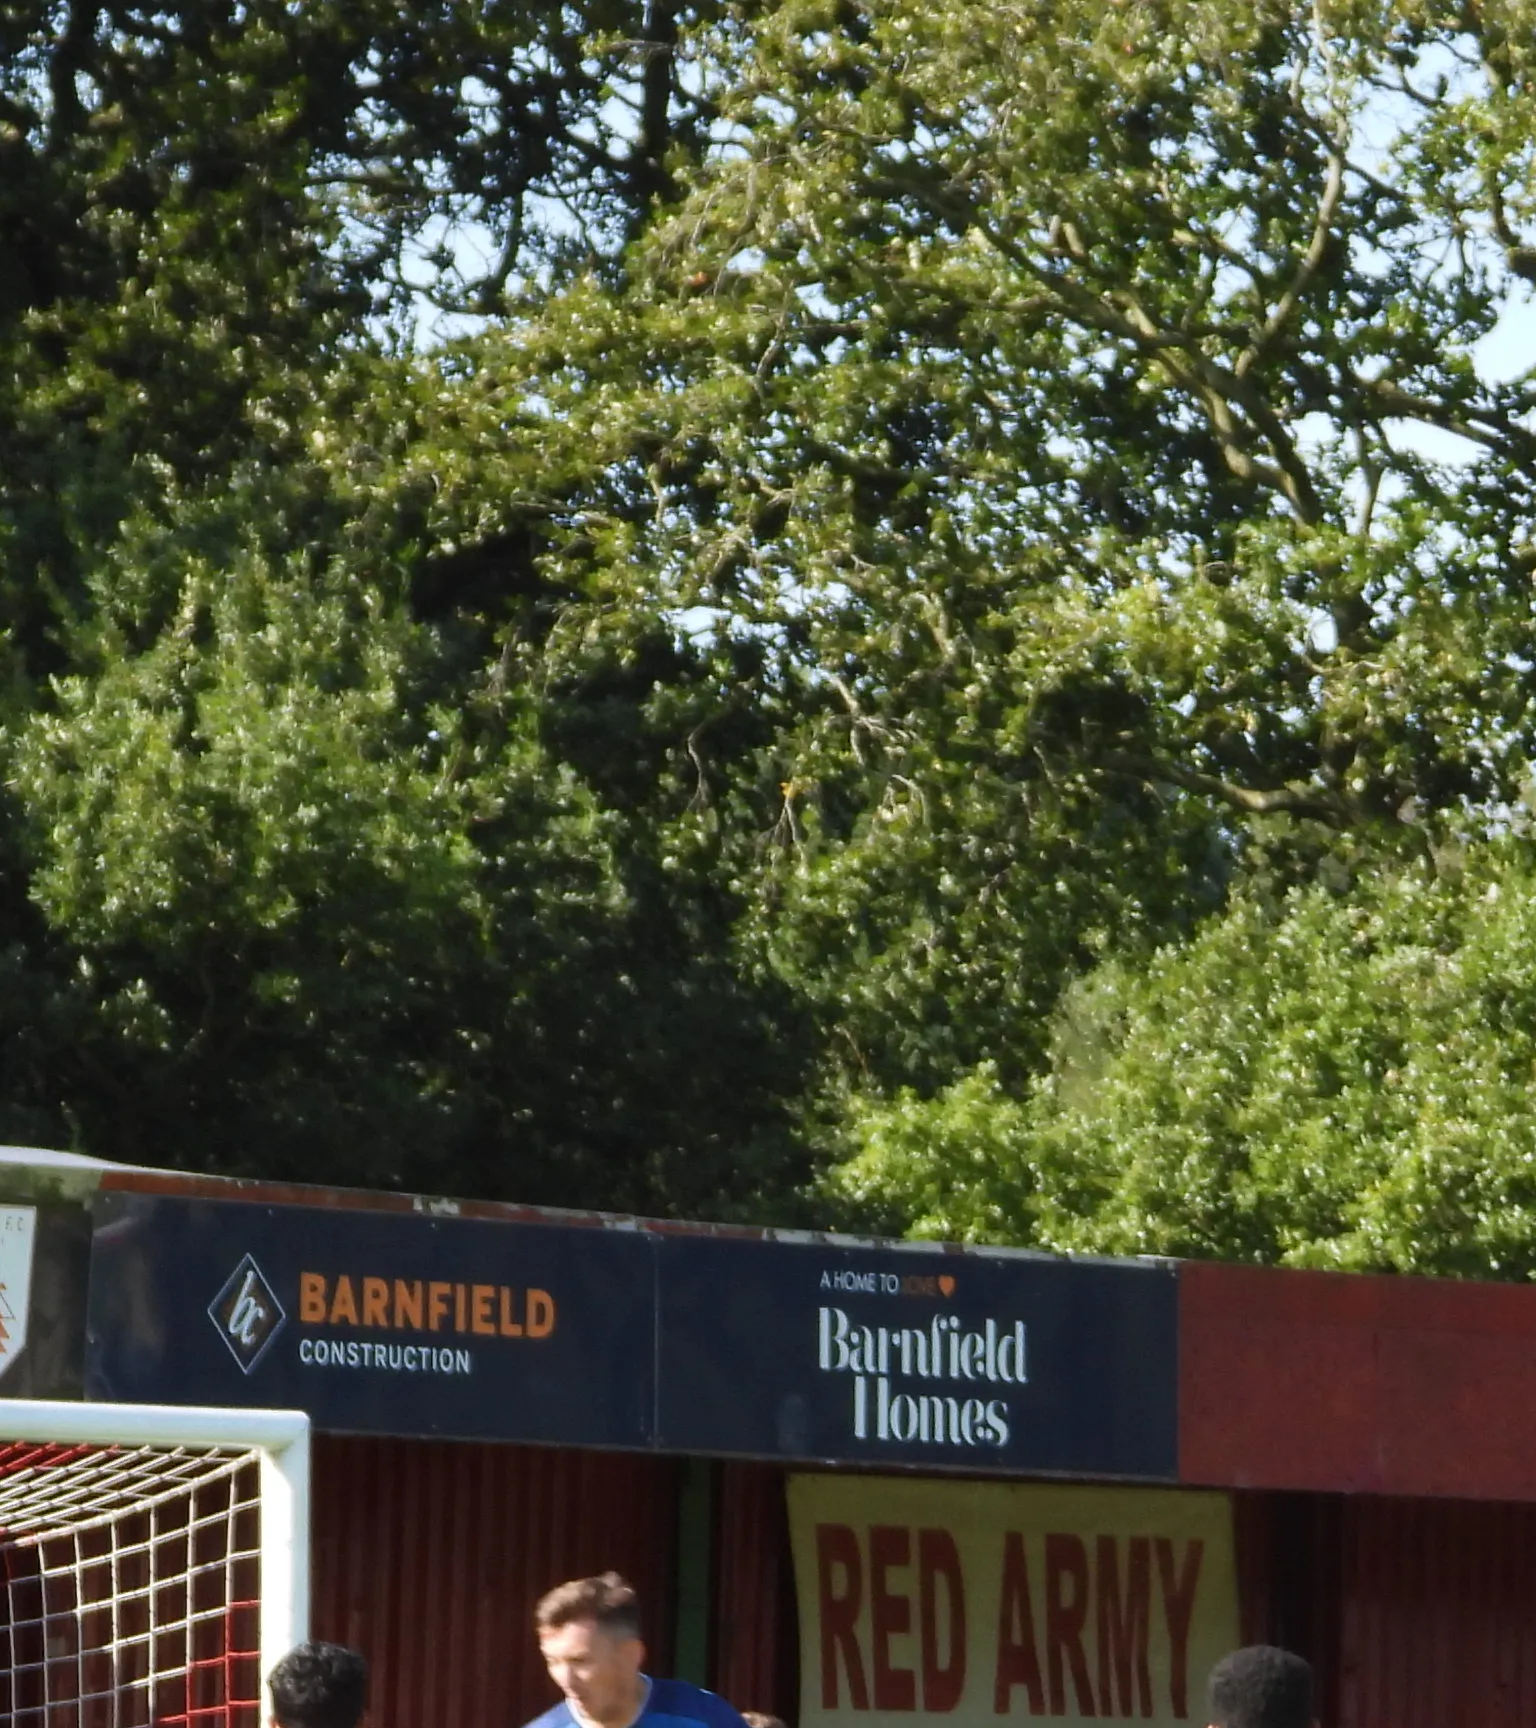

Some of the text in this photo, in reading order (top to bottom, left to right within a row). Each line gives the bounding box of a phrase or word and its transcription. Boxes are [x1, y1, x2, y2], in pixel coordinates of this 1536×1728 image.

[299, 1271, 556, 1339] BARNFIELD
[820, 1270, 832, 1289] A
[834, 1271, 876, 1293] HOME
[879, 1273, 899, 1294] TO
[299, 1338, 471, 1375] CONSTRUCTION
[818, 1307, 1029, 1384] Barnfield
[854, 1376, 1010, 1446] Homes
[816, 1523, 1204, 1719] RED ARMY
